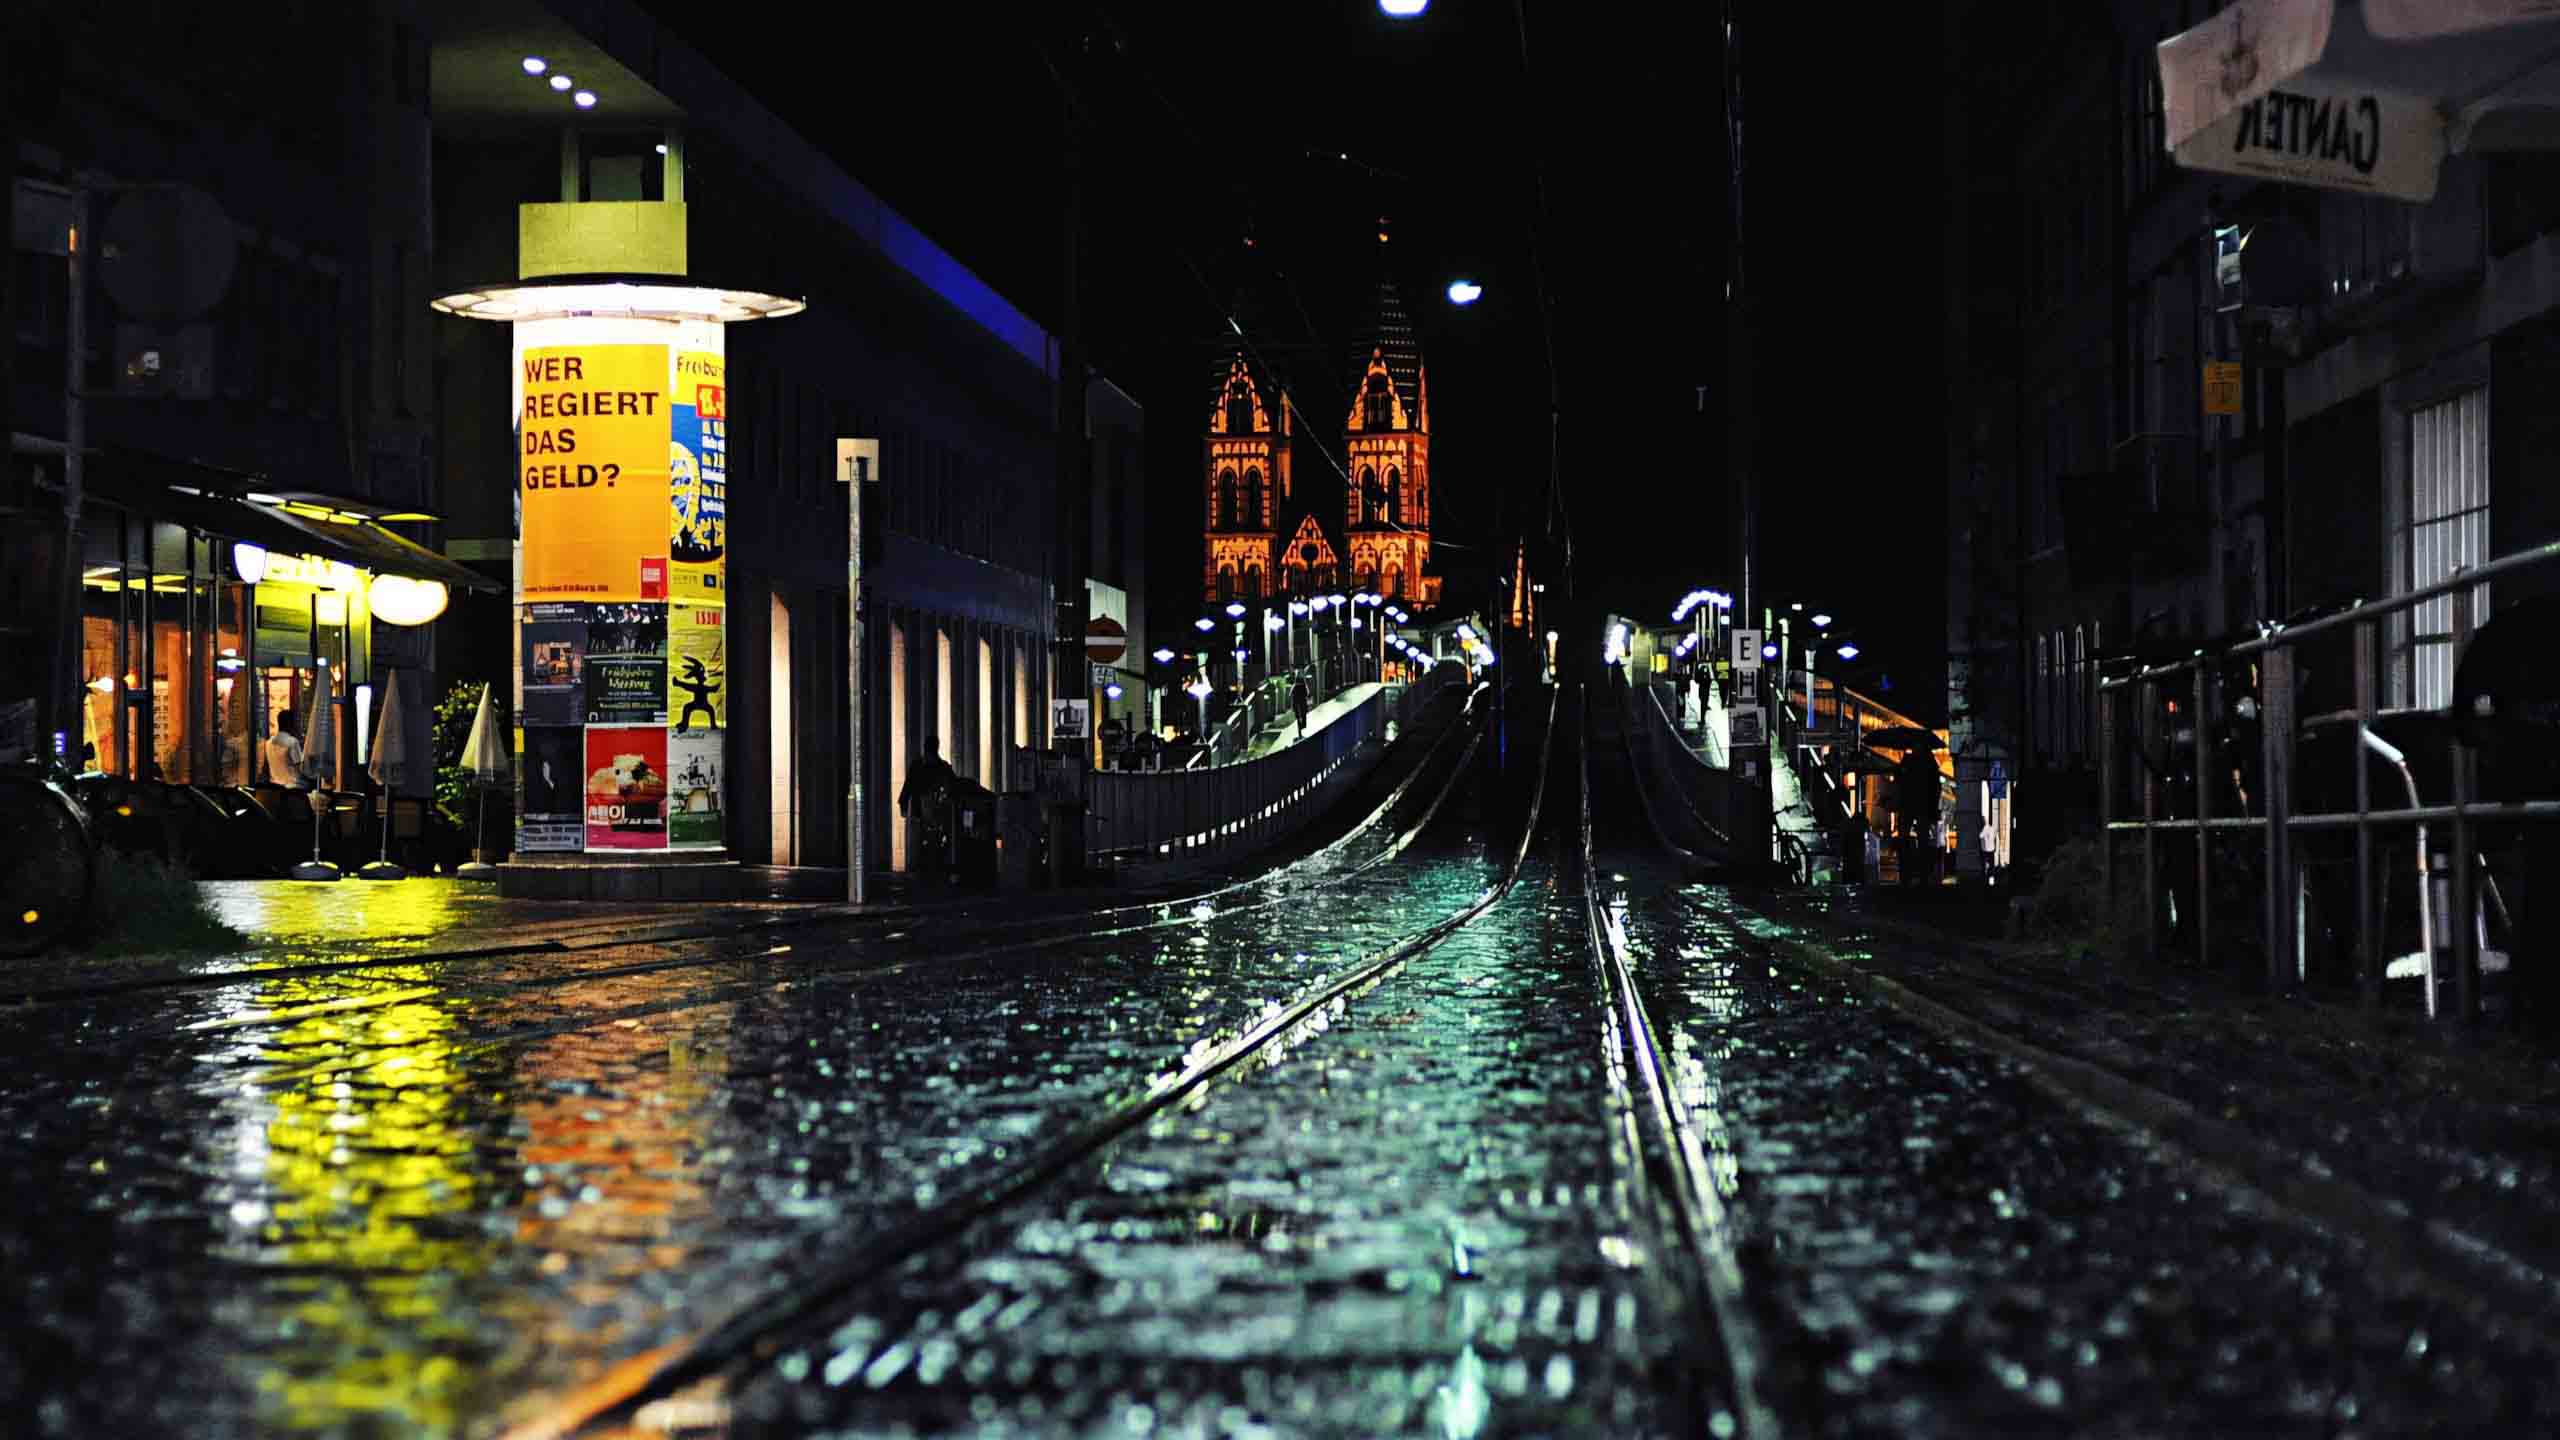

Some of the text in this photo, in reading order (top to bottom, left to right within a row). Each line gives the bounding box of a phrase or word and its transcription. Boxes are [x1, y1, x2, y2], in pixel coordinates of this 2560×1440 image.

[524, 357, 583, 382] WER
[525, 392, 659, 420] REGIERT
[525, 429, 576, 455] DAS
[525, 464, 620, 490] GELD?
[1740, 637, 1751, 660] E
